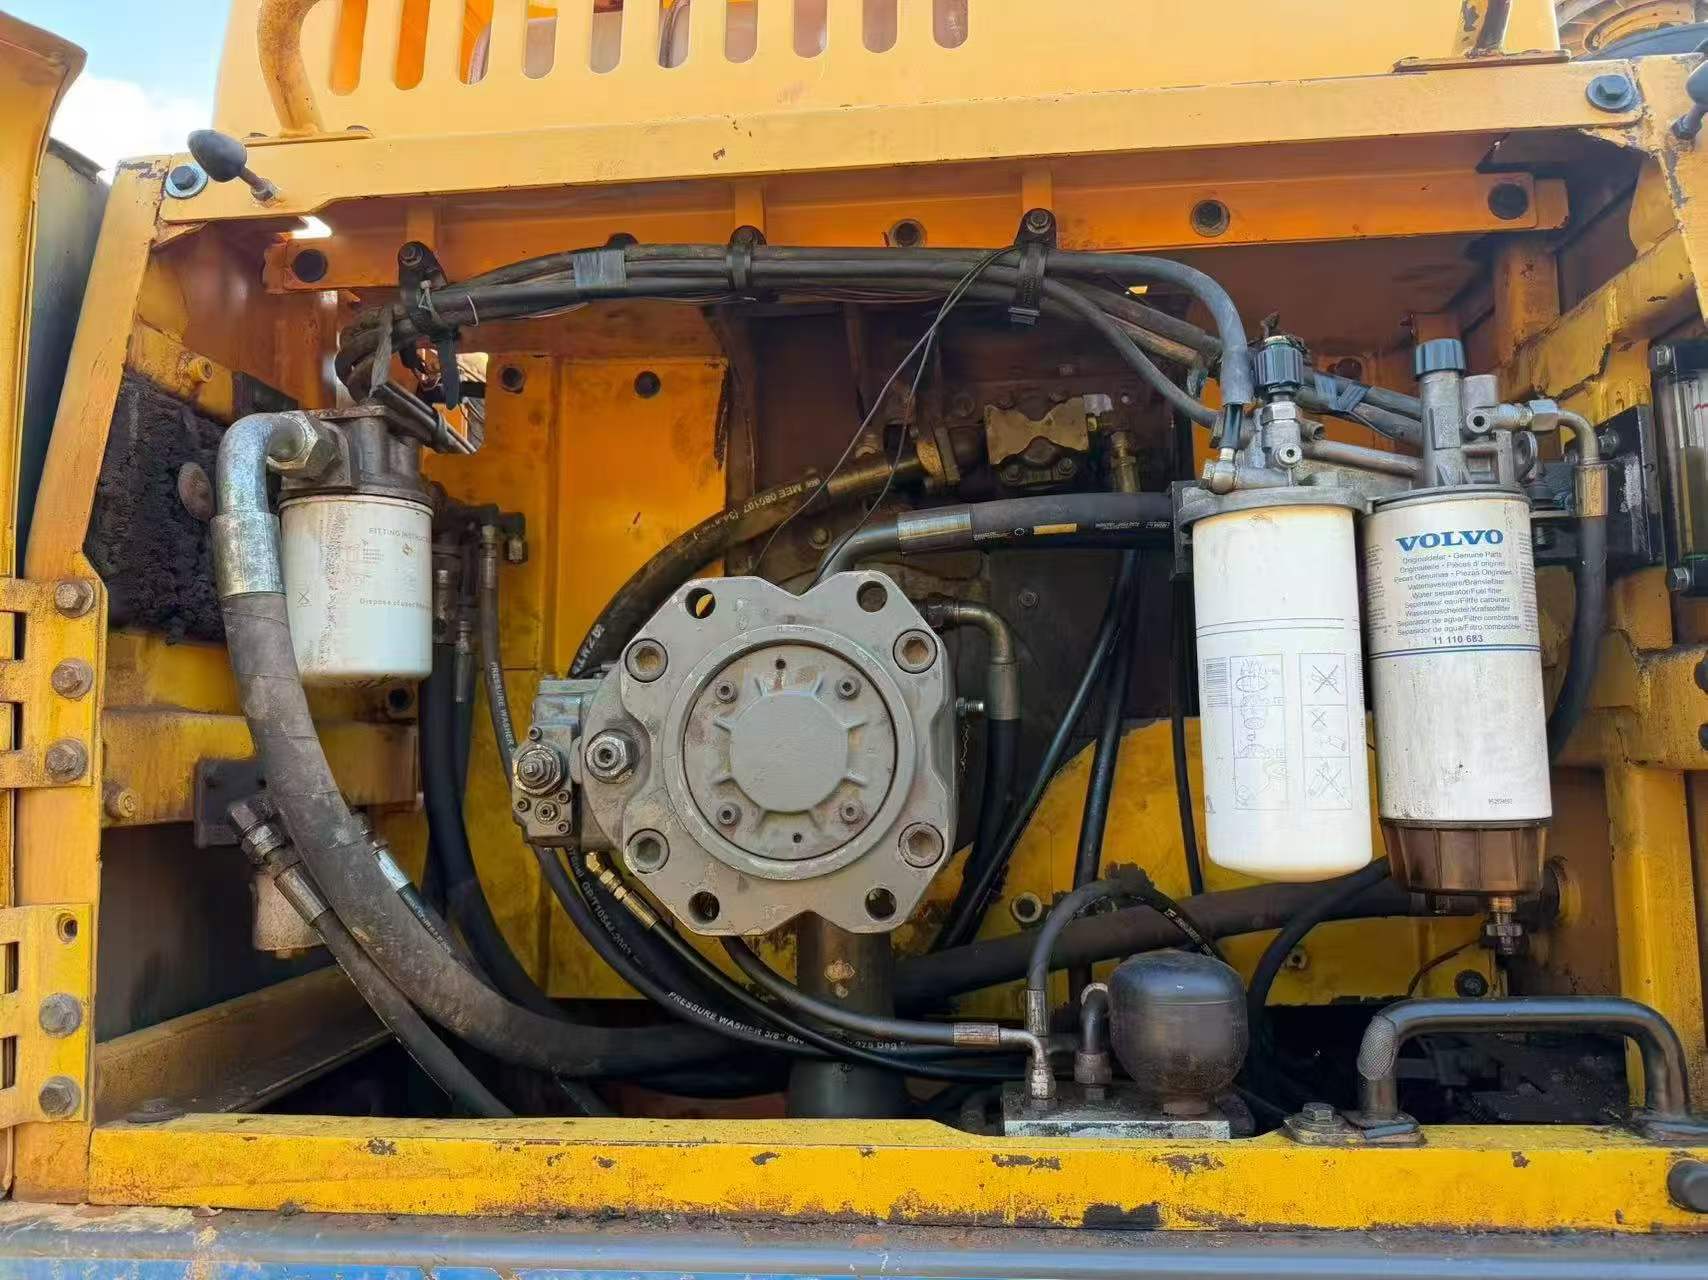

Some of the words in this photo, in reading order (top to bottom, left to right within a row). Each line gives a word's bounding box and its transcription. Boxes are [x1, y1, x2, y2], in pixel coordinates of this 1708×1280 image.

[779, 486, 802, 498] MEE
[368, 528, 400, 536] FITTING
[1396, 530, 1504, 551] VOLVO
[360, 598, 390, 606] Dispose
[1448, 636, 1463, 644] 110
[1466, 635, 1484, 643] 683
[500, 708, 514, 744] WASHER
[668, 991, 717, 1020] PRESSURE
[719, 1015, 762, 1036] WASHER
[877, 1040, 897, 1051] Deg
